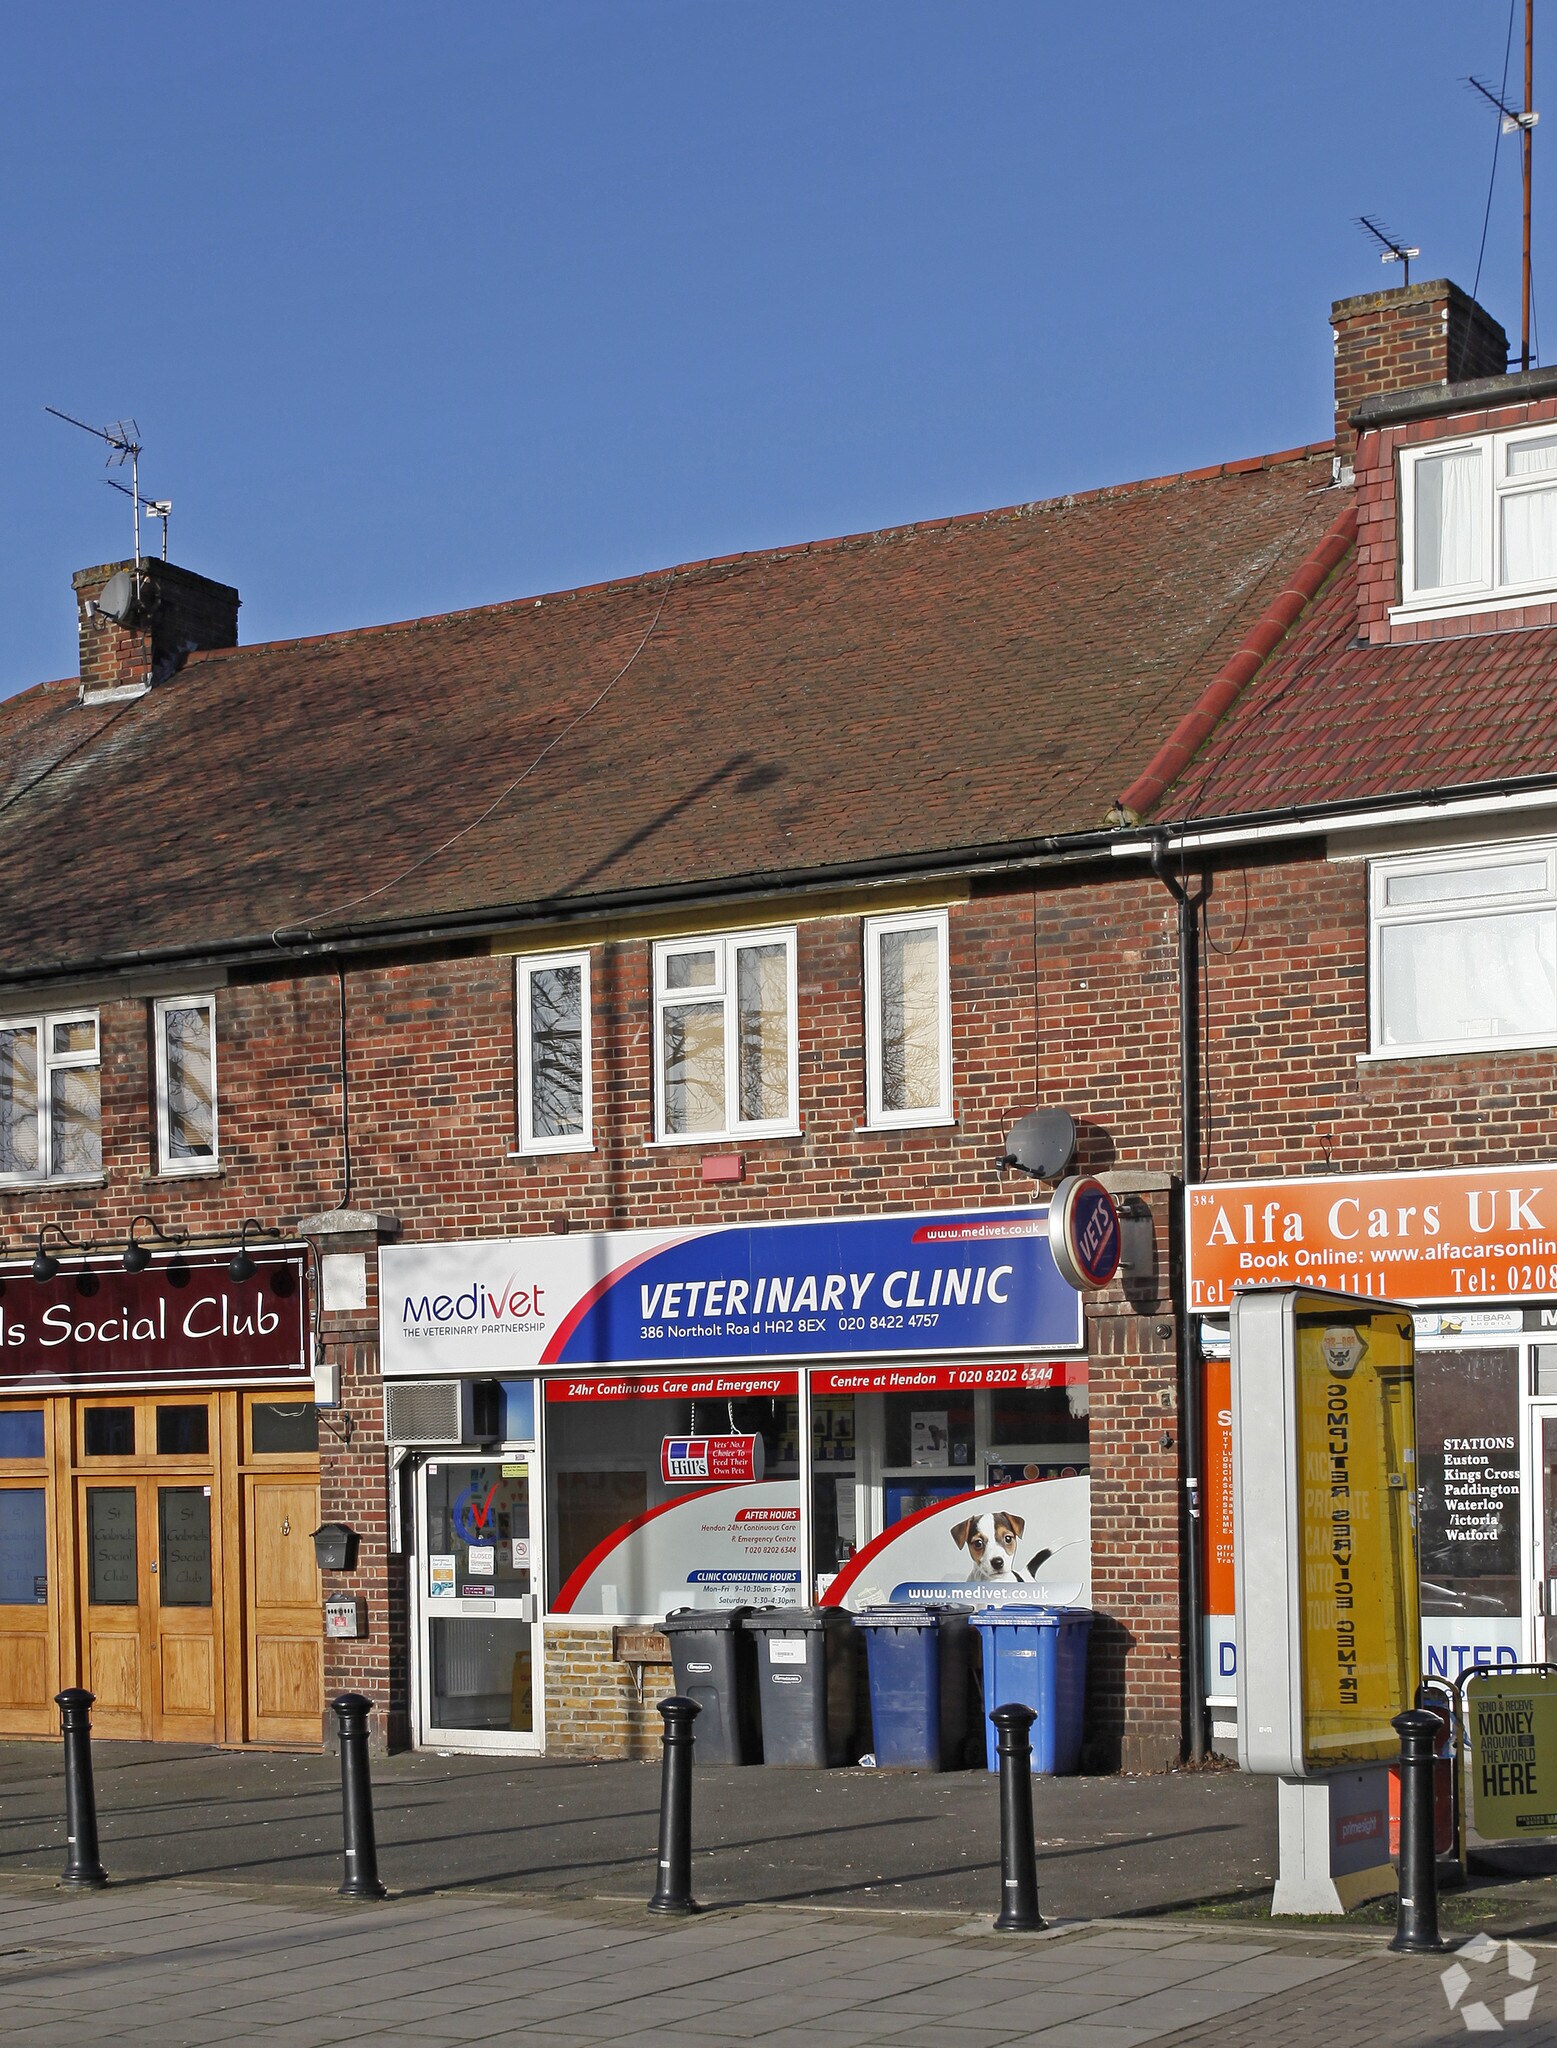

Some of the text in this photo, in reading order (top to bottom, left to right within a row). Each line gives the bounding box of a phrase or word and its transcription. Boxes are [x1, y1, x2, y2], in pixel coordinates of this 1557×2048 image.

[1193, 1195, 1215, 1206] 384
[1206, 1187, 1546, 1247] Alfa Cars UK
[927, 1223, 1039, 1239] www.medivet.co.uk
[1080, 1197, 1109, 1262] VETS
[1240, 1252, 1289, 1268] Book
[1295, 1249, 1363, 1267] Online:
[1339, 1272, 1386, 1296] 1111
[1451, 1267, 1496, 1293] Tel:
[640, 1265, 1013, 1320] VETERINARY CLINIC
[1192, 1279, 1223, 1303] Tel
[39, 1297, 166, 1347] Social
[182, 1292, 279, 1339] Club
[1471, 1313, 1512, 1322] LEBARA
[403, 1322, 546, 1338] THE VETERINARY PARTNERSHIP
[640, 1313, 939, 1340] 386 Northolt Road HA2 8EX 020 8422 4757
[830, 1367, 1054, 1387] Centre at Hendon T 020 8202 6344
[568, 1378, 780, 1396] 24hr Continuous Care and Emergency
[1443, 1437, 1515, 1451] STATIONS
[712, 1449, 736, 1457] Choice
[1443, 1454, 1489, 1465] Euston
[670, 1460, 707, 1475] Hill's
[712, 1458, 748, 1466] Feed Their
[713, 1467, 745, 1475] Own Pets
[1444, 1468, 1520, 1483] Kings Cross
[1444, 1484, 1519, 1497] Paddington
[1444, 1499, 1504, 1511] Waterloo
[107, 1507, 121, 1521] St
[180, 1507, 194, 1521] St
[745, 1510, 797, 1520] AFTER HOURS
[701, 1524, 726, 1532] Hendon
[727, 1524, 742, 1532] 24hr
[743, 1524, 780, 1532] Continuous
[1445, 1529, 1498, 1541] Watford
[738, 1535, 774, 1543] Emergency
[98, 1549, 132, 1562] Social
[170, 1550, 206, 1563] Social
[744, 1546, 797, 1554] T 020 8202 6344
[103, 1569, 129, 1583] Club
[175, 1571, 202, 1584] Club
[697, 1572, 797, 1581] CLINIC CONSULTING HOURS
[1306, 1562, 1334, 1594] INTO
[908, 1586, 1049, 1600] www.medivet.co.uk
[719, 1596, 748, 1605] Saturday
[1478, 1699, 1534, 1713] SEND & RECEIVE
[1478, 1711, 1534, 1736] MONEY
[1481, 1735, 1517, 1749] AROUND
[1481, 1747, 1536, 1763] THE WORLD
[1482, 1762, 1538, 1797] HERE
[1342, 1815, 1377, 1840] primesight
